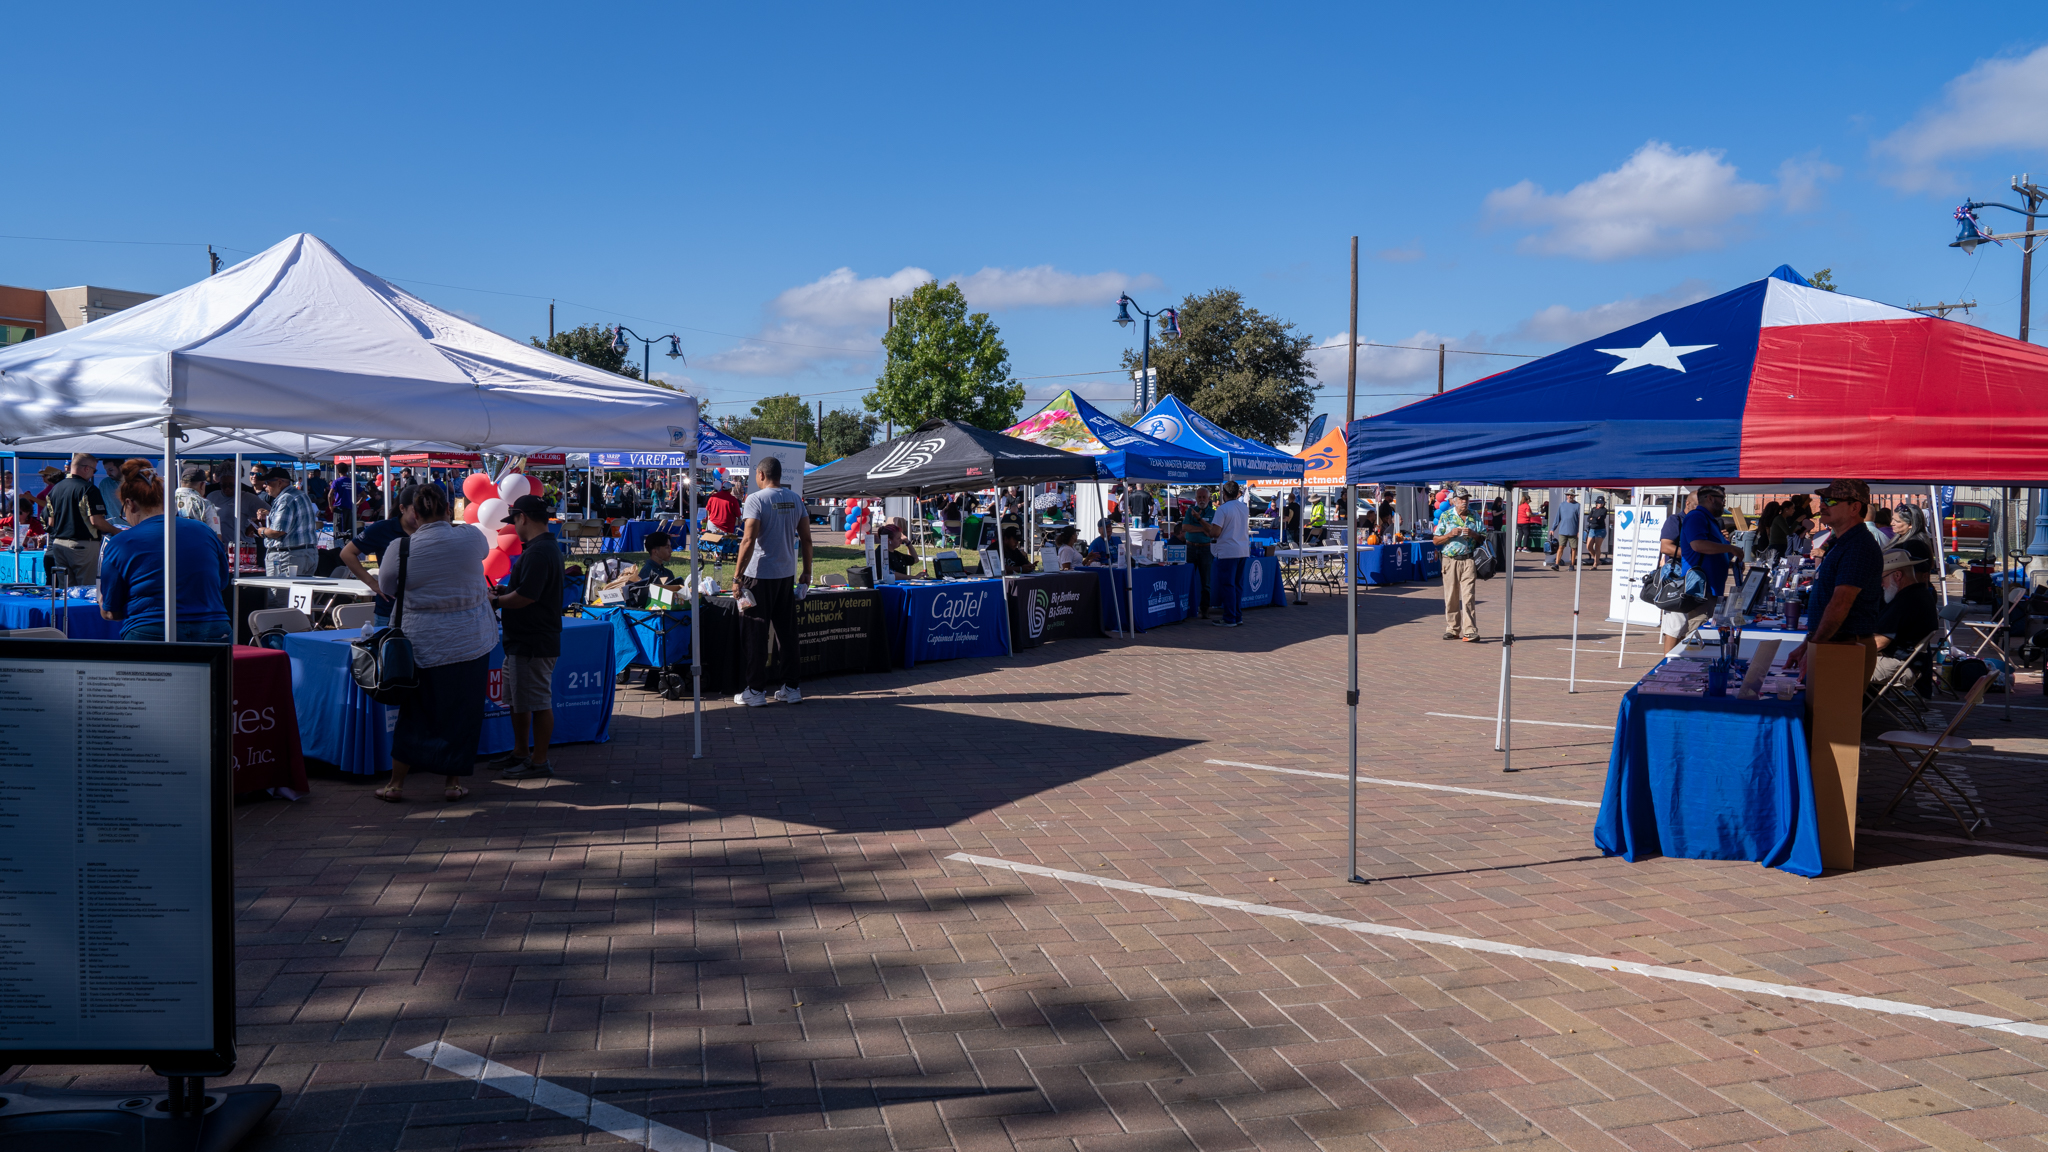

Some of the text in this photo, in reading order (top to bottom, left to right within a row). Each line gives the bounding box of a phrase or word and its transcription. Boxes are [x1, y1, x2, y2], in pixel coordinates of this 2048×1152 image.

[630, 454, 684, 466] VAREP.net
[294, 595, 306, 609] 57
[839, 598, 872, 608] Veteran
[927, 632, 955, 645] Captioned
[233, 700, 275, 734] ies
[247, 747, 275, 766] Inc.
